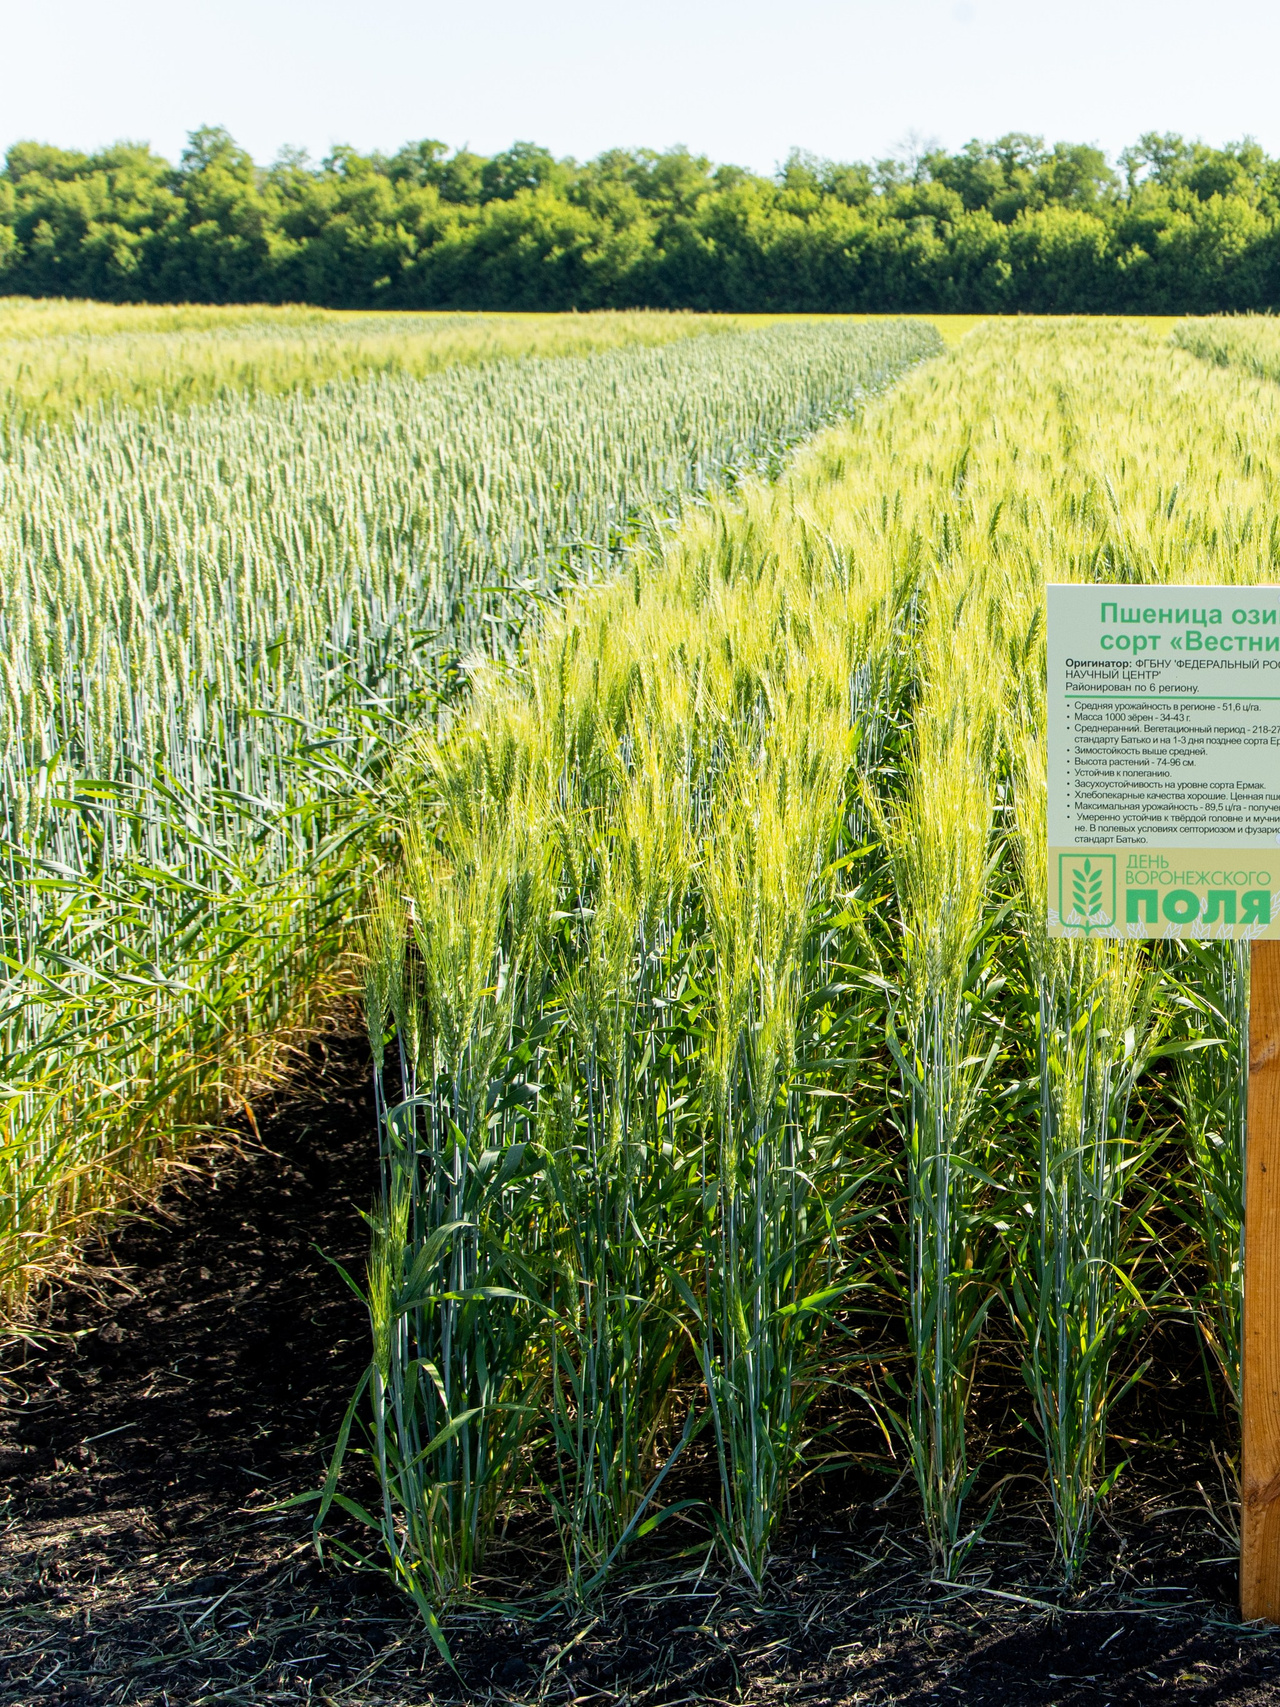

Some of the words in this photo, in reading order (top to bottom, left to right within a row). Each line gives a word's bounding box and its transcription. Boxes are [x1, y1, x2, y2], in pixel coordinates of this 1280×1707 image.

[1101, 602, 1221, 627] Пшеница
[1100, 634, 1160, 655] сорт
[1065, 658, 1132, 669] Оригинатор:
[1135, 659, 1171, 668] ФГБНУ
[1065, 668, 1118, 678] НАУЧНЫЙ
[1065, 682, 1131, 693] Районирован
[1149, 682, 1155, 691] 6
[1158, 685, 1199, 694] региону.
[1074, 700, 1112, 711] Средняя
[1114, 702, 1171, 712] урожайность
[1180, 704, 1215, 712] регионе
[1222, 702, 1240, 711] 51,6
[1242, 703, 1261, 712] ц/га.
[1074, 712, 1102, 720] Масса
[1105, 712, 1126, 721] 1000
[1127, 713, 1153, 722] зёрен
[1160, 713, 1184, 721] 34-43
[1074, 723, 1142, 733] Среднеранний.
[1144, 724, 1211, 733] Вегетационный
[1214, 726, 1245, 734] период
[1074, 736, 1119, 745] стандарту
[1074, 746, 1140, 754] Зимостойкость
[1168, 747, 1208, 757] средней.
[1109, 758, 1149, 767] растений
[1156, 758, 1180, 766] 74-96
[1074, 768, 1114, 776] Устойчив
[1074, 779, 1162, 789] Засухоустойчивость
[1177, 782, 1208, 790] уровне
[1236, 780, 1266, 790] Ермак.
[1074, 790, 1144, 800] Хлебопекарные
[1230, 792, 1263, 801] Ценная
[1074, 801, 1140, 810] Максимальная
[1141, 802, 1198, 812] урожайность
[1204, 802, 1223, 811] 89,5
[1225, 803, 1241, 811] ц/га
[1076, 812, 1120, 822] Умеренно
[1122, 813, 1162, 823] устойчив
[1170, 814, 1206, 823] твёрдой
[1137, 826, 1177, 834] условиях
[1179, 826, 1235, 834] септориозом
[1074, 836, 1114, 844] стандарт
[1116, 835, 1148, 843] Батько.
[1126, 854, 1170, 869] ДЕНЬ
[1125, 869, 1271, 886] ВОРОНЕЖСКОГО
[1126, 889, 1270, 924] ПОЛЯ
